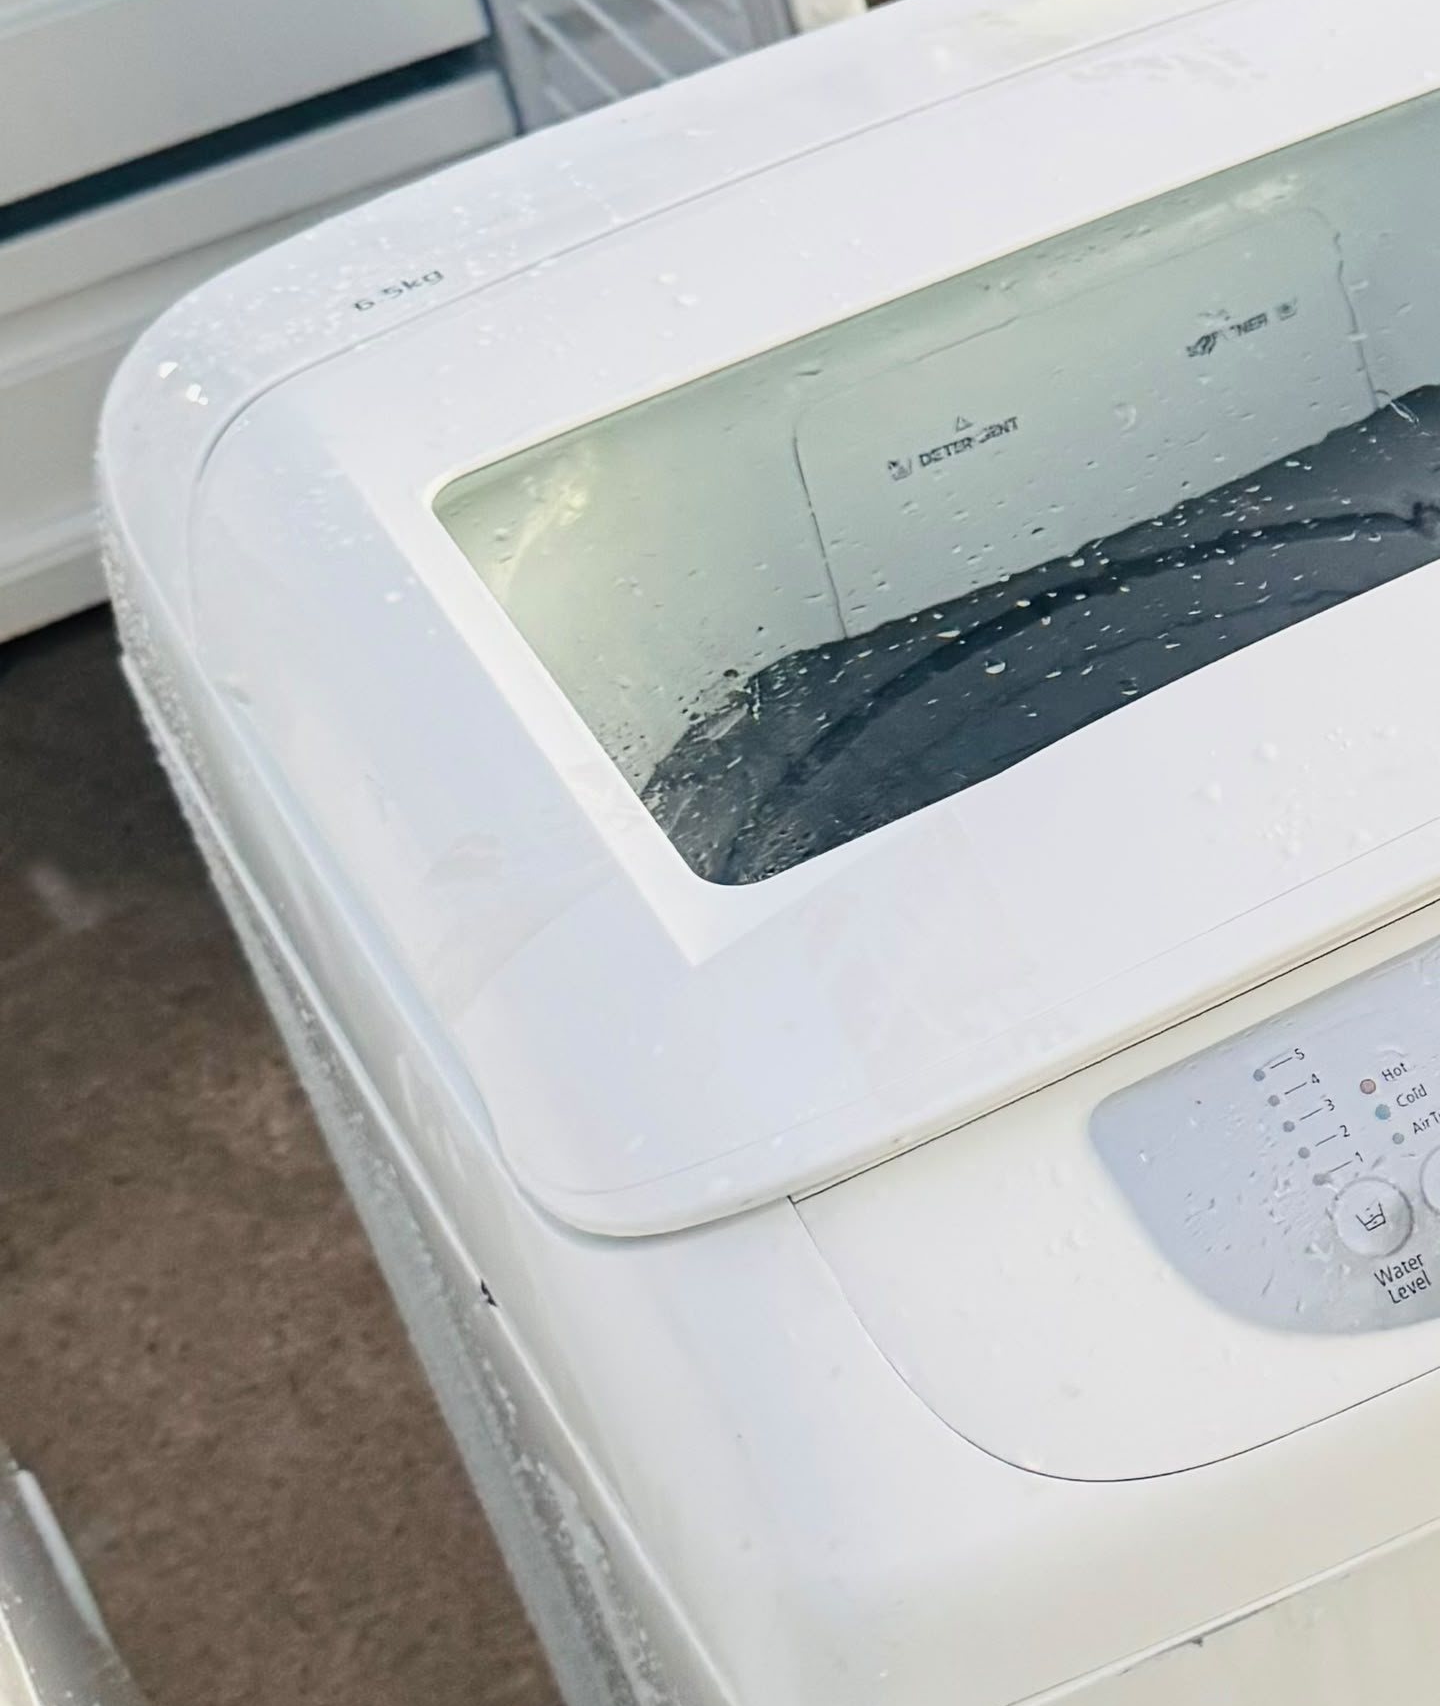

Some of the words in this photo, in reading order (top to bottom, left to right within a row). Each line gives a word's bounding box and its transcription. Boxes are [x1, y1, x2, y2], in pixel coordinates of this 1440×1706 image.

[1310, 1072, 1321, 1087] 4
[1381, 1062, 1408, 1082] Hot
[1324, 1098, 1336, 1113] 3
[1396, 1083, 1428, 1108] Cold
[1339, 1124, 1351, 1140] 2
[1373, 1252, 1424, 1289] Water
[1387, 1269, 1432, 1306] Level
